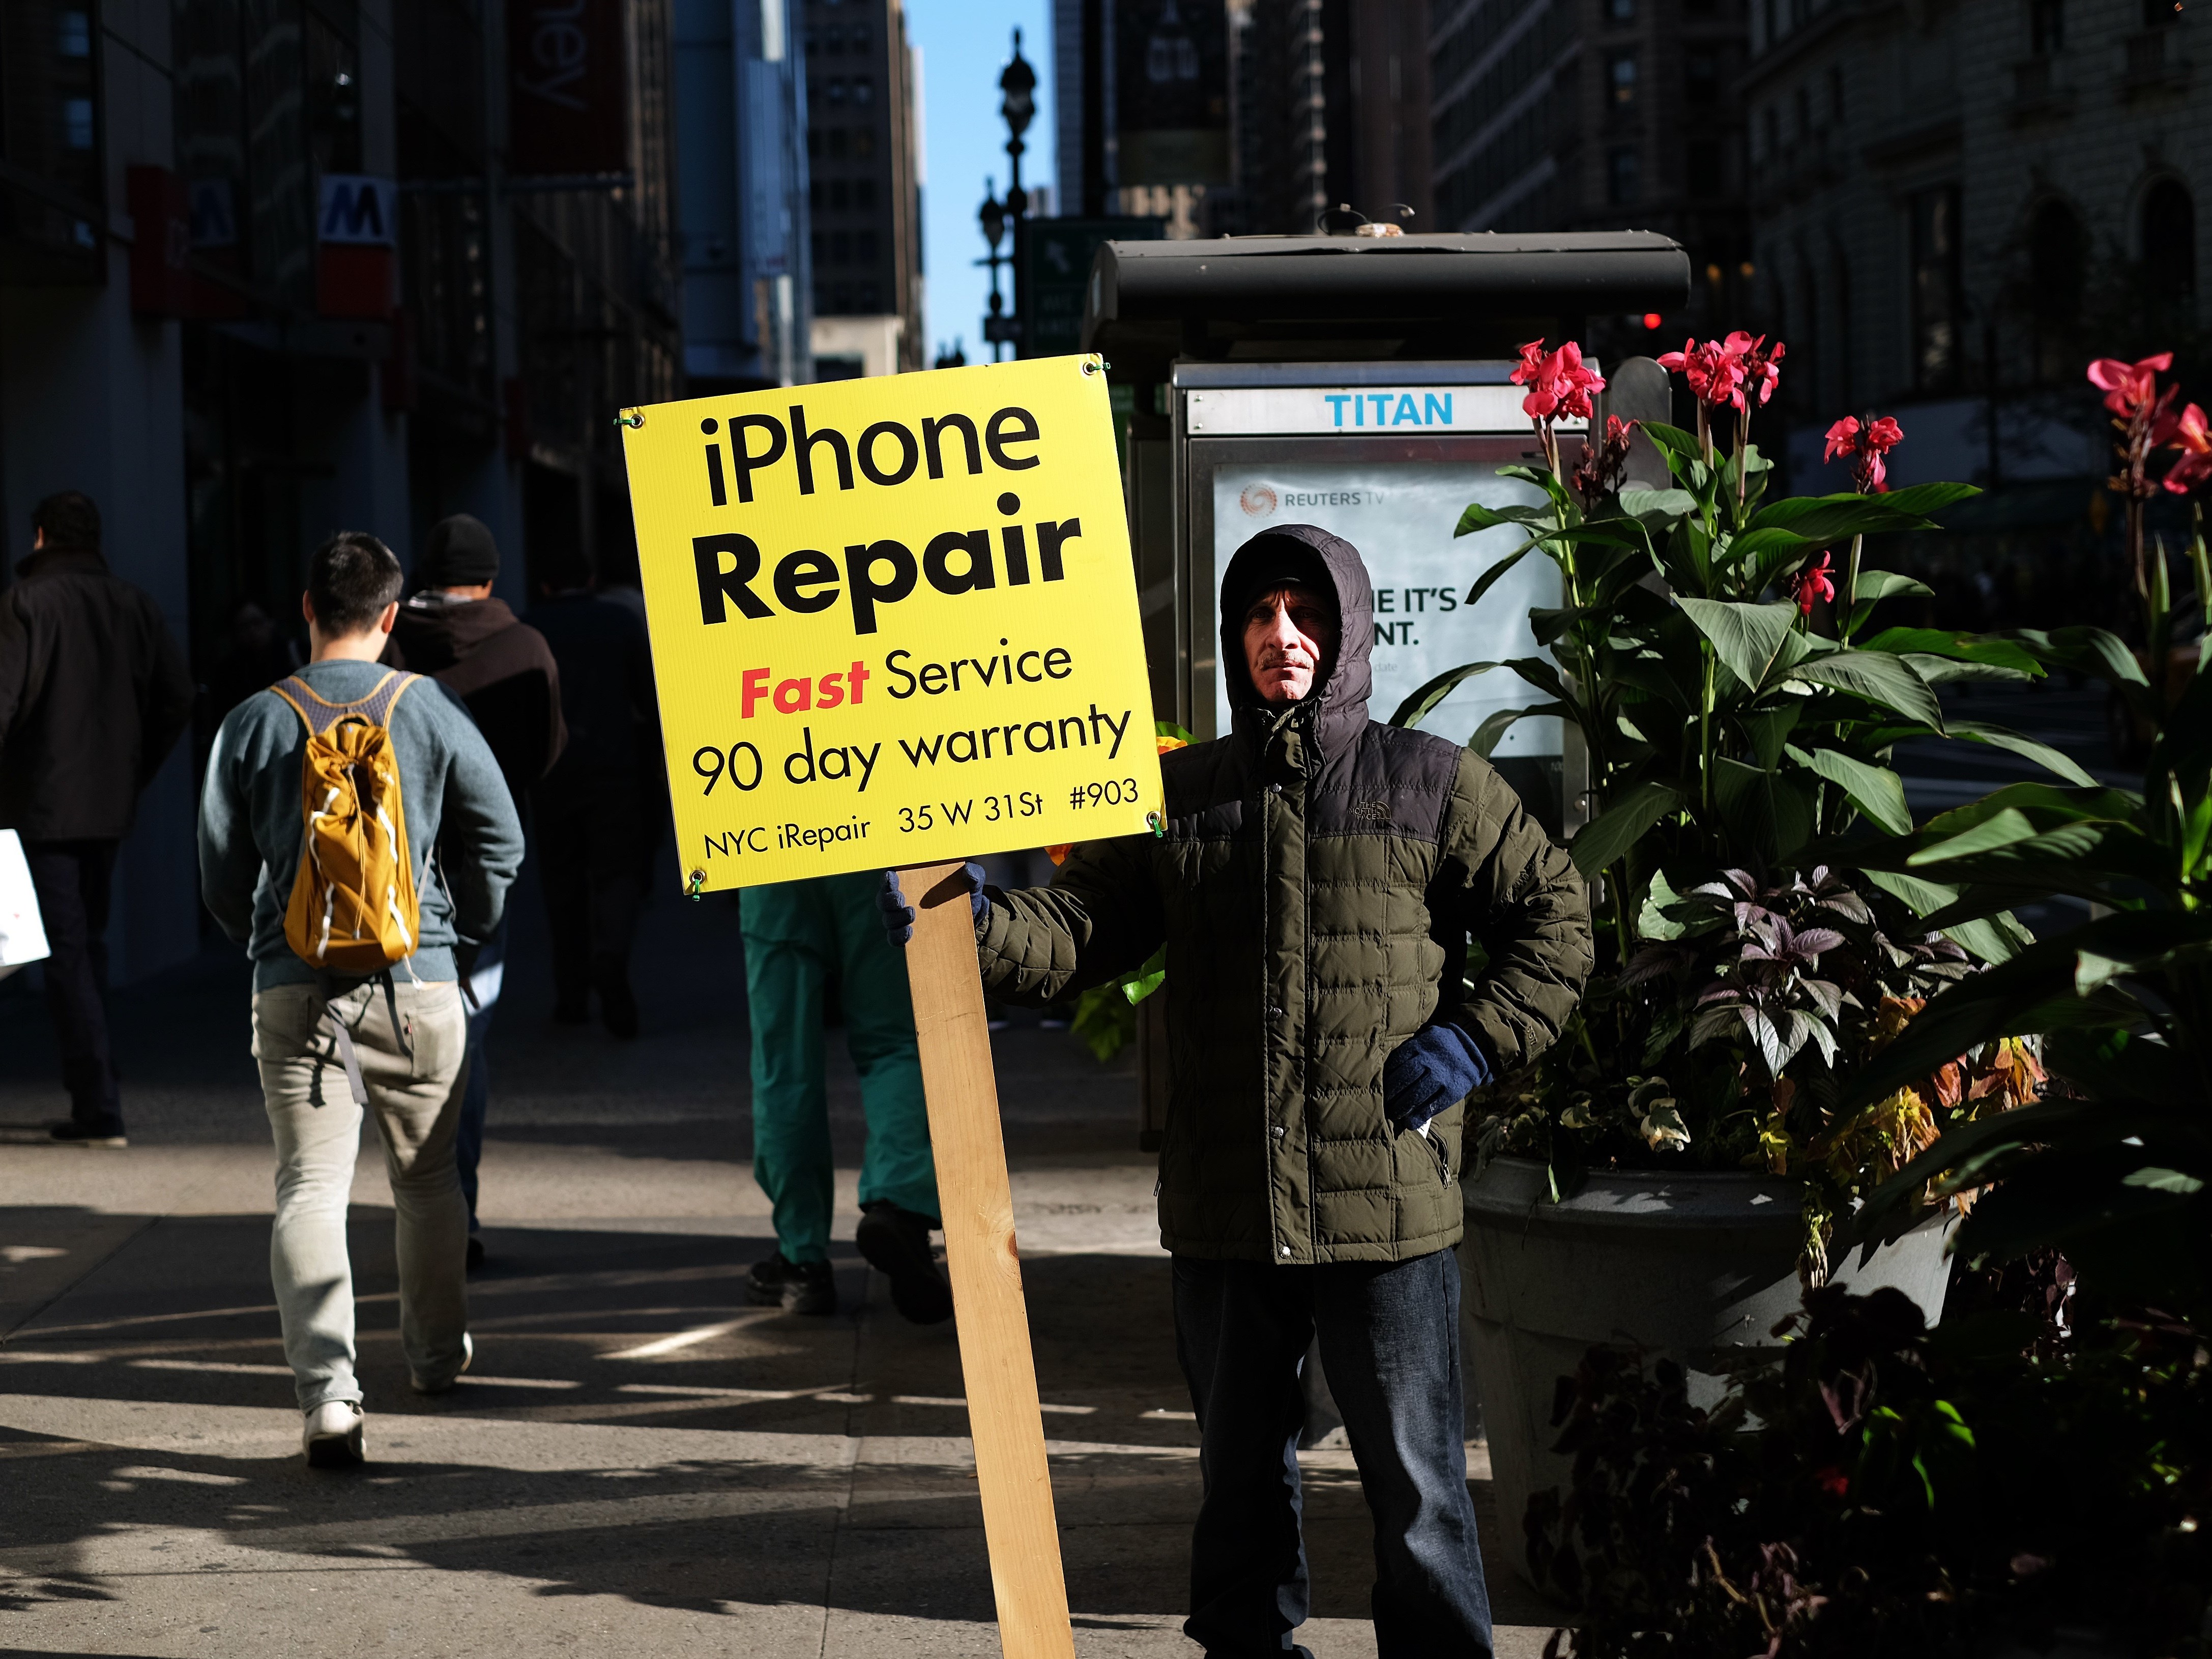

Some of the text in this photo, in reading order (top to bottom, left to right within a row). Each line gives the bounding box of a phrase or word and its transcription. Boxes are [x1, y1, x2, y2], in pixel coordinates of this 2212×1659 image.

[1325, 393, 1452, 426] TITAN
[701, 405, 1040, 506] iPhone
[1285, 491, 1384, 506] REUTERS TV
[692, 492, 1082, 635] Repair
[1372, 588, 1457, 613] E IT'S
[742, 638, 1072, 718] Fast Service
[693, 704, 1131, 796] 90 day warranty
[705, 778, 1138, 858] NYC iRepair 35 W 31St #903
